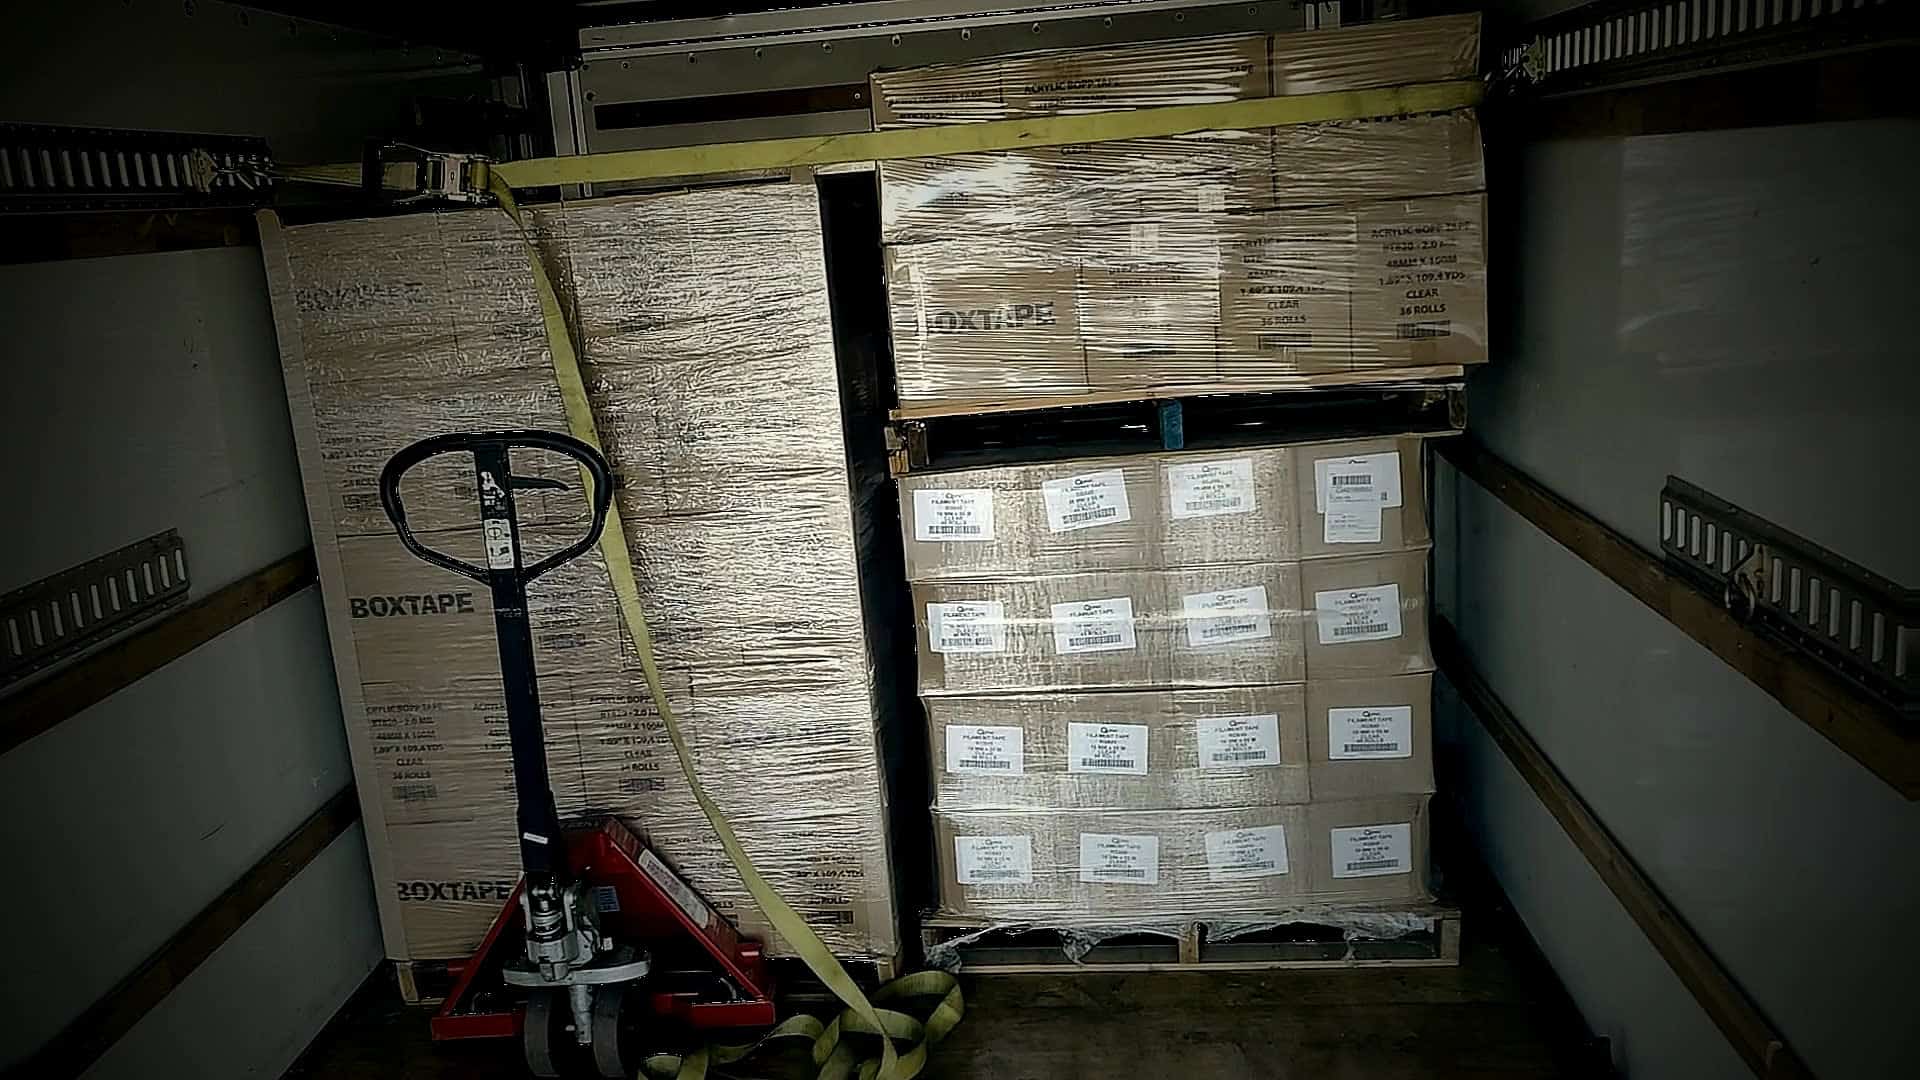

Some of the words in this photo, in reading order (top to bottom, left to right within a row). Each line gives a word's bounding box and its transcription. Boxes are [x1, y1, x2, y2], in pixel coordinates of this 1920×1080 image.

[1406, 288, 1439, 299] CLEAR
[1414, 304, 1446, 315] ROLLS
[349, 592, 474, 619] BOXTAPE
[397, 880, 513, 902] BOXTAPE
